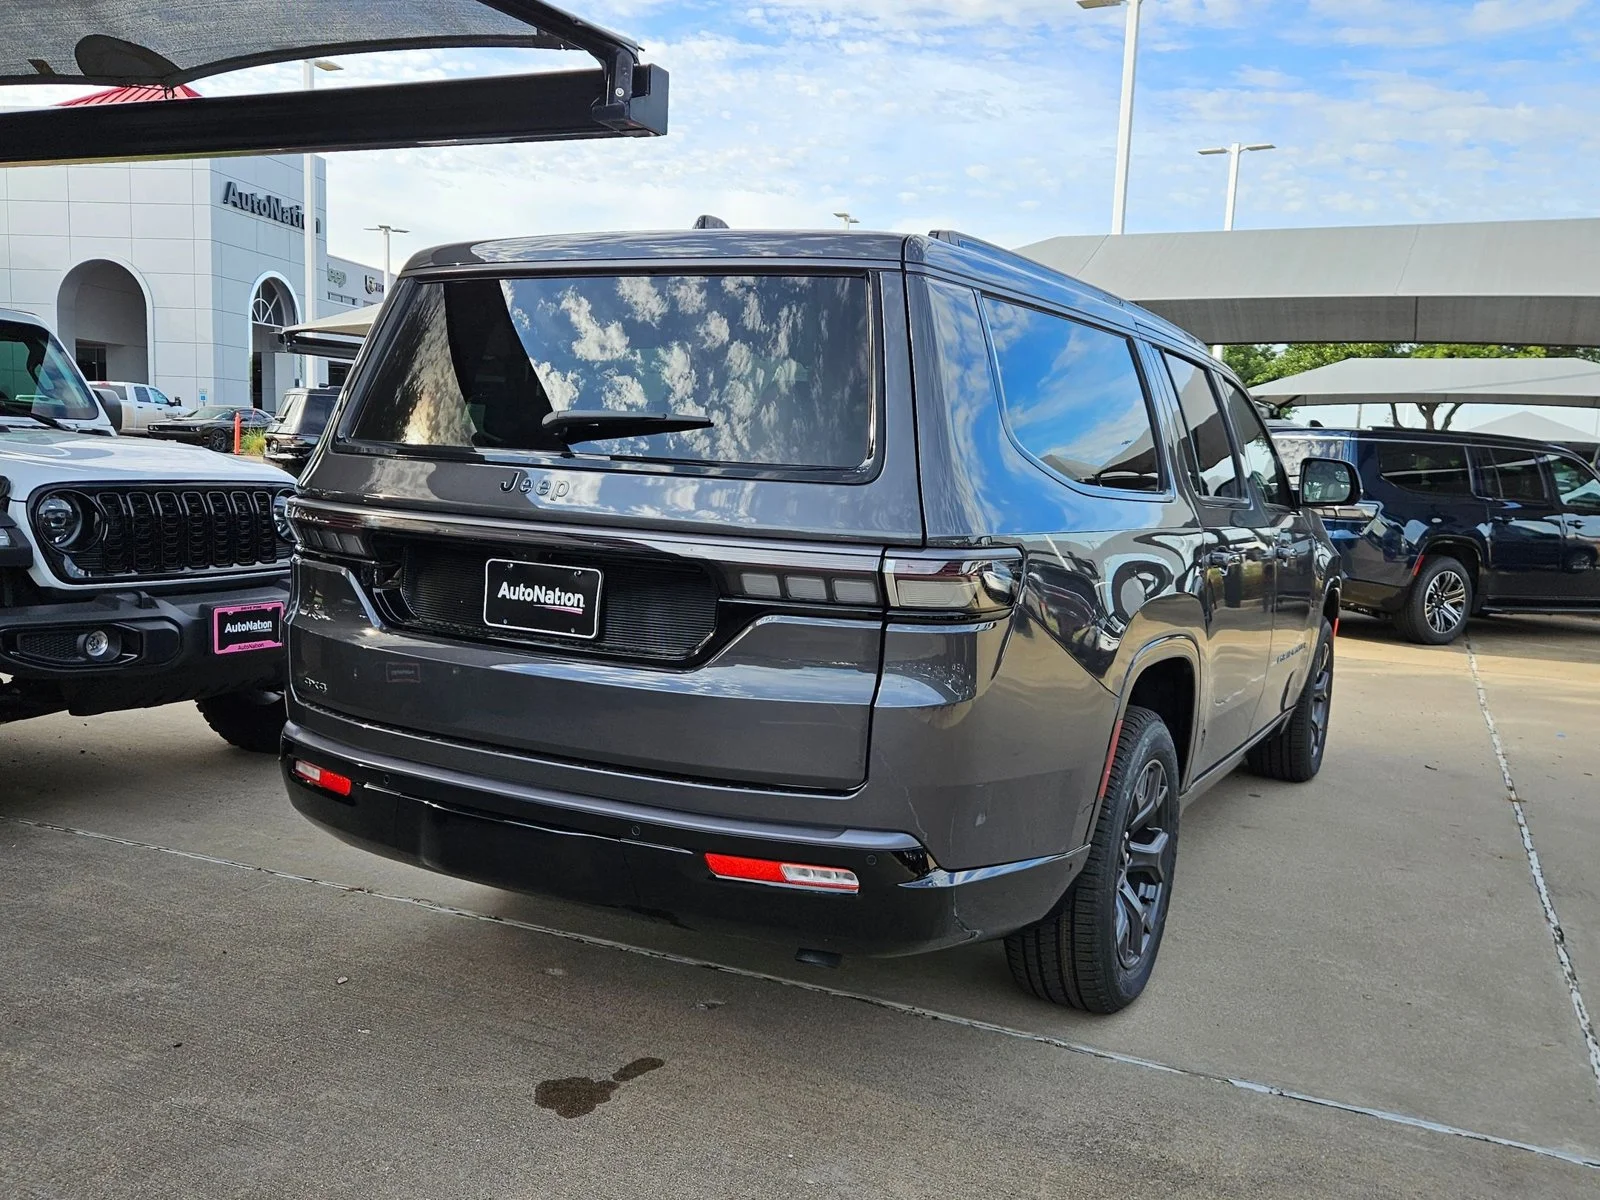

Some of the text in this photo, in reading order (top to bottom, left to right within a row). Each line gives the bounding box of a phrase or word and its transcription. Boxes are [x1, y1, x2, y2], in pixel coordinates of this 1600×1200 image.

[223, 181, 320, 234] AutoNatin
[500, 471, 569, 502] Jeep
[497, 581, 585, 607] AutoNation
[224, 620, 272, 633] AutoNation
